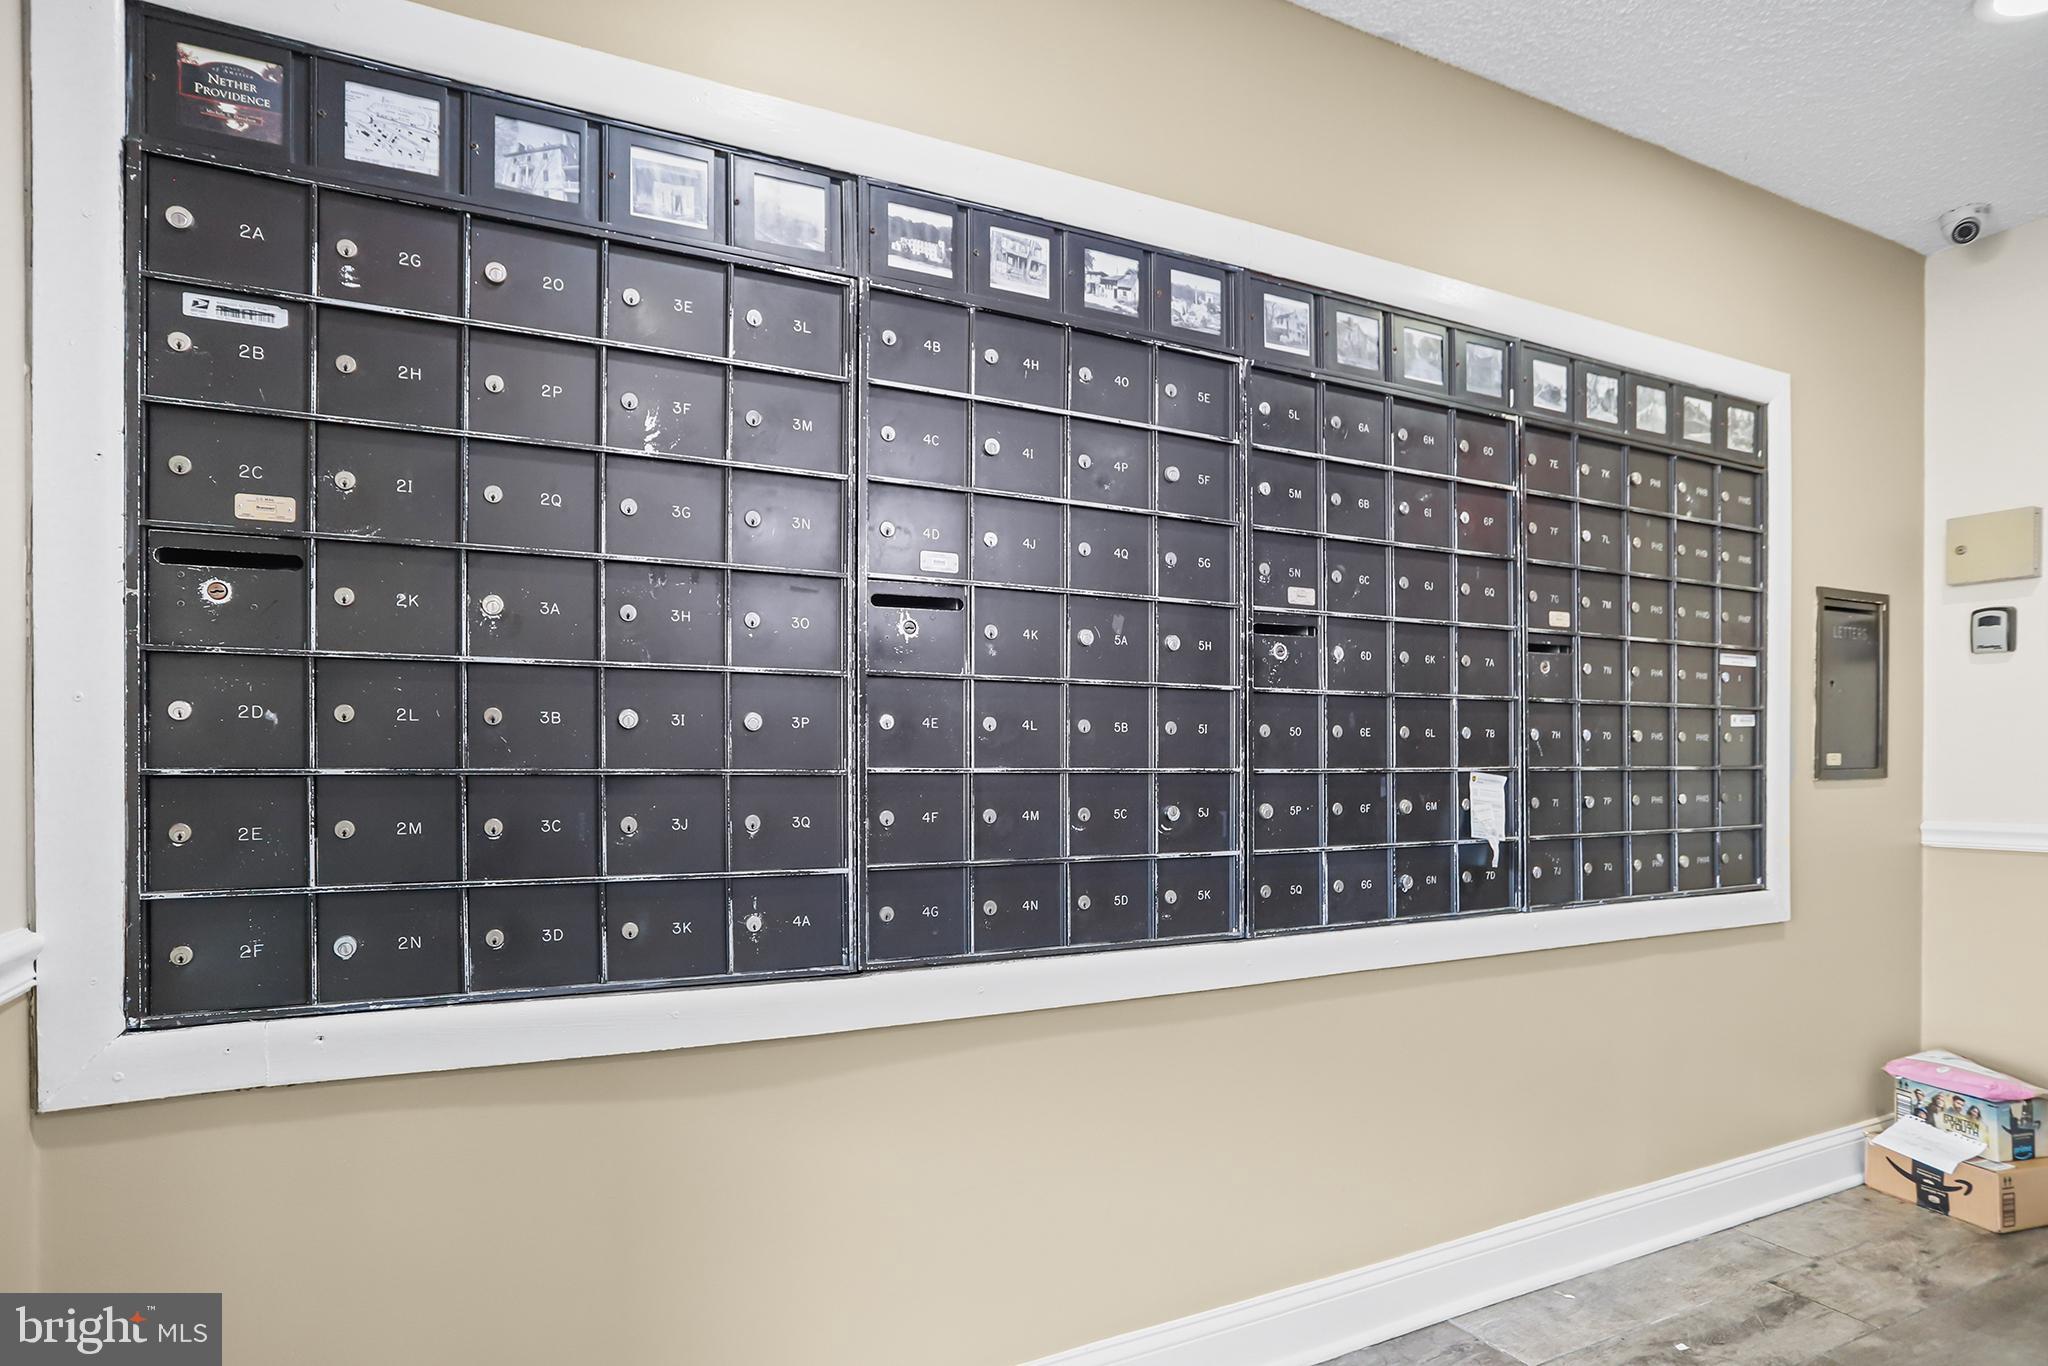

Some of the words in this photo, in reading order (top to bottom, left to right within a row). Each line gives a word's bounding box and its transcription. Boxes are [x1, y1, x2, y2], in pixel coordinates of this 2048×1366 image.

[207, 72, 258, 93] NETHER
[193, 82, 271, 108] PROVIDENCE
[239, 223, 265, 241] 2A
[398, 251, 422, 268] 2G
[673, 298, 693, 314] 3E
[793, 319, 812, 334] 3L
[238, 343, 265, 360] 2B
[923, 339, 941, 353] 4B
[1022, 358, 1039, 371] 4H
[398, 365, 422, 381] 2H
[541, 384, 563, 398] 2P
[1197, 391, 1211, 404] 5E
[672, 401, 692, 415] 3F
[1288, 408, 1300, 421] 5L
[792, 418, 813, 432] 3M
[1358, 422, 1370, 433] 6A
[922, 433, 940, 447] 4C
[1423, 434, 1435, 446] 6H
[1022, 448, 1034, 460] 4I
[1113, 461, 1129, 473] 4P
[1549, 458, 1559, 470] 7E
[238, 464, 263, 480] 2C
[1601, 468, 1611, 479] 7K
[396, 478, 413, 493] 2I
[1197, 474, 1211, 485] 5F
[1288, 488, 1302, 499] 5M
[540, 492, 562, 508] 2Q
[1357, 498, 1370, 509] 6B
[671, 505, 691, 519] 3G
[1423, 507, 1432, 518] 6I
[791, 516, 811, 530] 3N
[1483, 516, 1494, 527] 6P
[922, 527, 940, 540] 4D
[1549, 526, 1559, 536] 7F
[1022, 538, 1036, 550] 4J
[1601, 534, 1611, 545] 7L
[1113, 547, 1129, 560] 4Q
[1197, 557, 1211, 569] 5G
[1288, 567, 1301, 578] 5N
[1358, 574, 1370, 585] 6C
[1424, 580, 1434, 591] 6J
[1484, 587, 1495, 598] 6Q
[396, 593, 419, 609] 2K
[1550, 594, 1560, 604] 7G
[1601, 599, 1612, 609] 7M
[539, 601, 561, 615] 3A
[670, 609, 691, 623] 3H
[1022, 628, 1039, 640] 4K
[1832, 625, 1868, 641] LETTERS
[1114, 634, 1128, 646] 5A
[1198, 640, 1212, 651] 5H
[1360, 650, 1372, 661] 6D
[1424, 654, 1436, 664] 6K
[1484, 657, 1495, 667] 7A
[238, 704, 264, 719] 2D
[396, 707, 420, 722] 2L
[539, 711, 561, 725] 3B
[671, 713, 685, 727] 3I
[791, 716, 810, 729] 3P
[921, 717, 939, 729] 4E
[1021, 719, 1038, 731] 4L
[1113, 721, 1129, 733] 5B
[1197, 723, 1208, 735] 5I
[1359, 727, 1372, 738] 6E
[1424, 728, 1436, 738] 6L
[1485, 728, 1496, 738] 7B
[1551, 730, 1561, 739] 7H
[1425, 801, 1438, 812] 6M
[1603, 796, 1613, 805] 7P
[1113, 808, 1128, 820] 5C
[1197, 807, 1210, 818] 5J
[1289, 805, 1302, 816] 5P
[1359, 803, 1371, 814] 6F
[921, 811, 939, 823] 4F
[1021, 810, 1040, 821] 4M
[396, 821, 422, 835] 2M
[540, 819, 562, 833] 3C
[671, 818, 688, 831] 3J
[791, 816, 811, 829] 3Q
[238, 826, 263, 841] 2E
[1553, 866, 1562, 876] 7J
[1603, 862, 1613, 872] 7Q
[1425, 875, 1437, 885] 6N
[1485, 870, 1496, 880] 7D
[1289, 884, 1303, 895] 5Q
[1360, 879, 1373, 890] 6G
[1113, 894, 1129, 906] 5D
[1197, 889, 1211, 901] 5K
[922, 905, 939, 918] 4G
[1022, 900, 1039, 911] 4N
[792, 915, 811, 927] 4A
[672, 921, 692, 935] 3K
[542, 928, 564, 942] 3D
[398, 936, 422, 950] 2N
[239, 943, 264, 959] 2F
